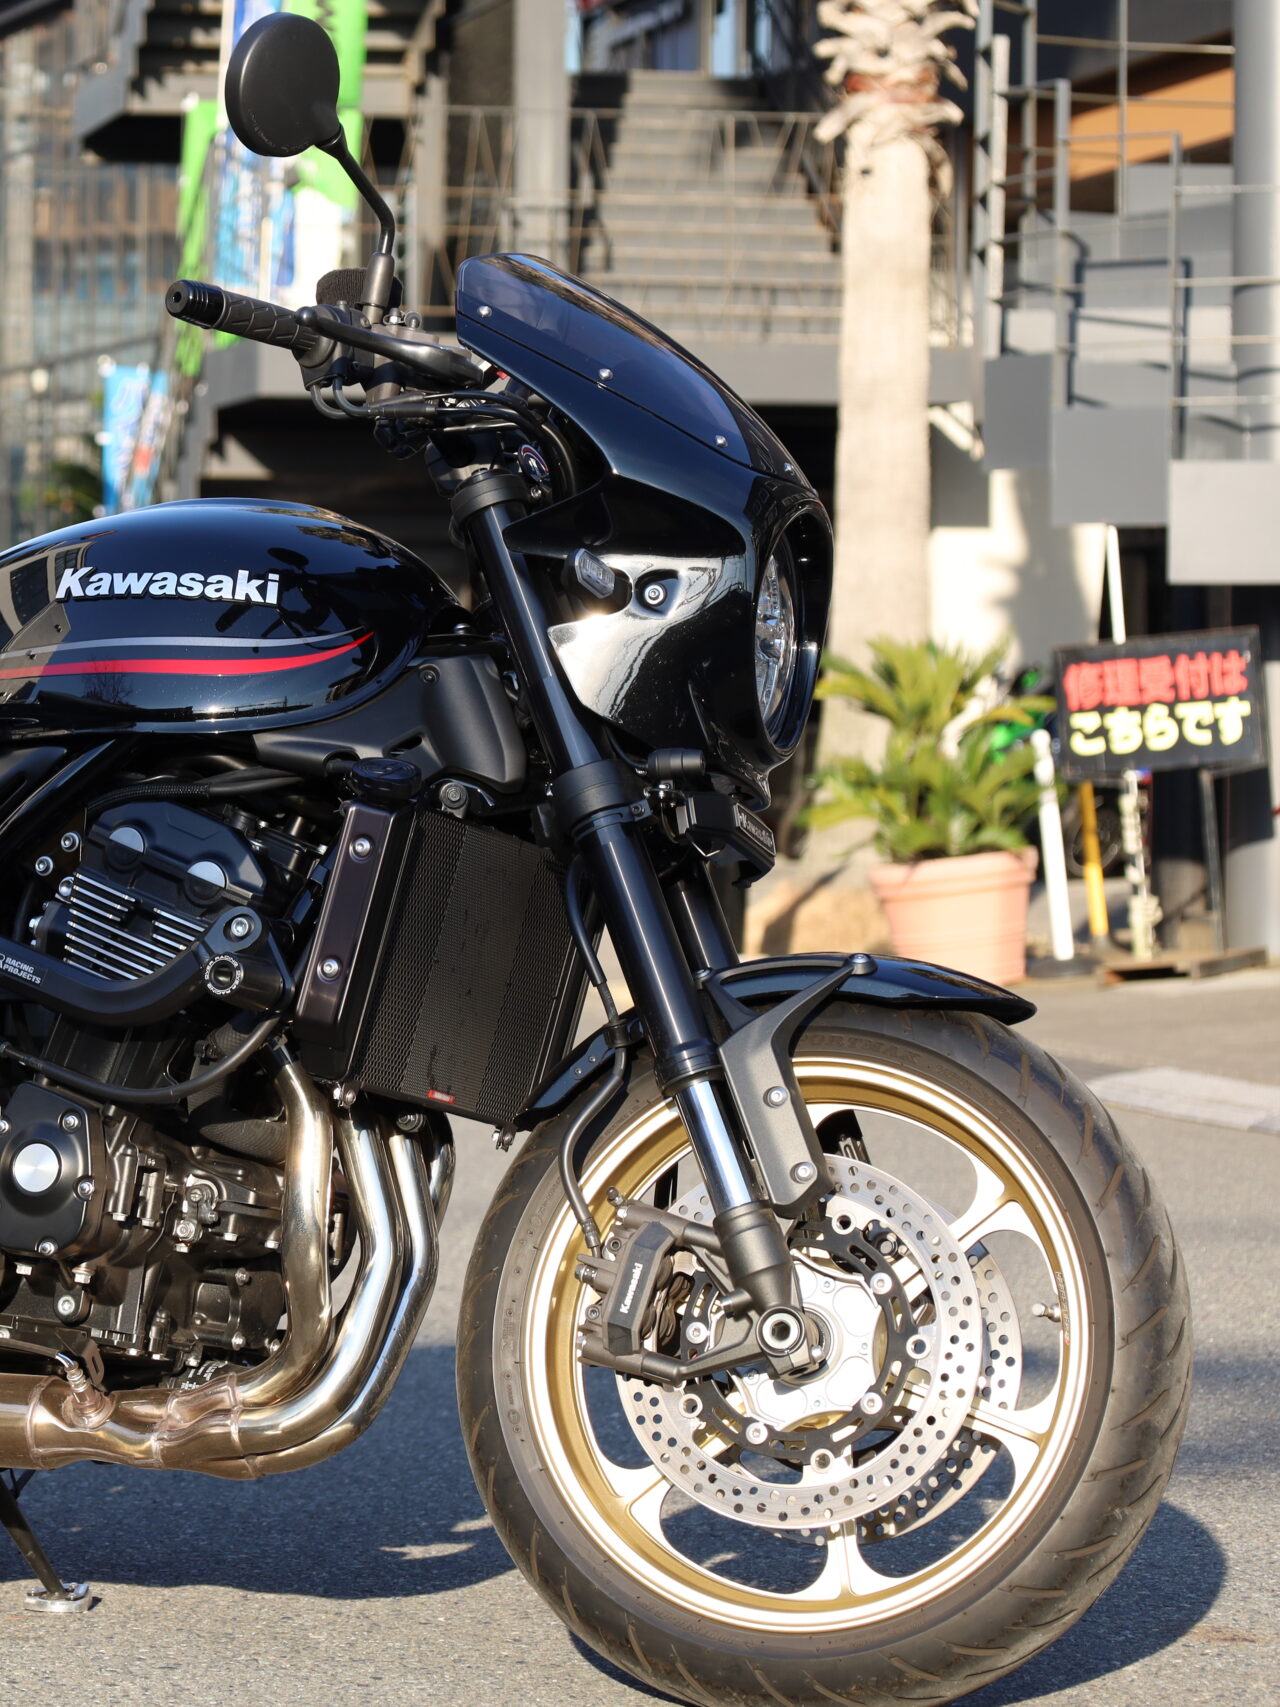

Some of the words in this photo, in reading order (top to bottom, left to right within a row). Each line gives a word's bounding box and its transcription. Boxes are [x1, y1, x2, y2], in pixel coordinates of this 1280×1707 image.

[56, 566, 280, 605] Kawasaki
[1064, 650, 1249, 712] 修理受付は
[1070, 696, 1251, 757] こちらです
[3, 963, 42, 985] PROJECTS
[5, 957, 35, 974] RACING
[619, 1262, 643, 1314] Kawasaki
